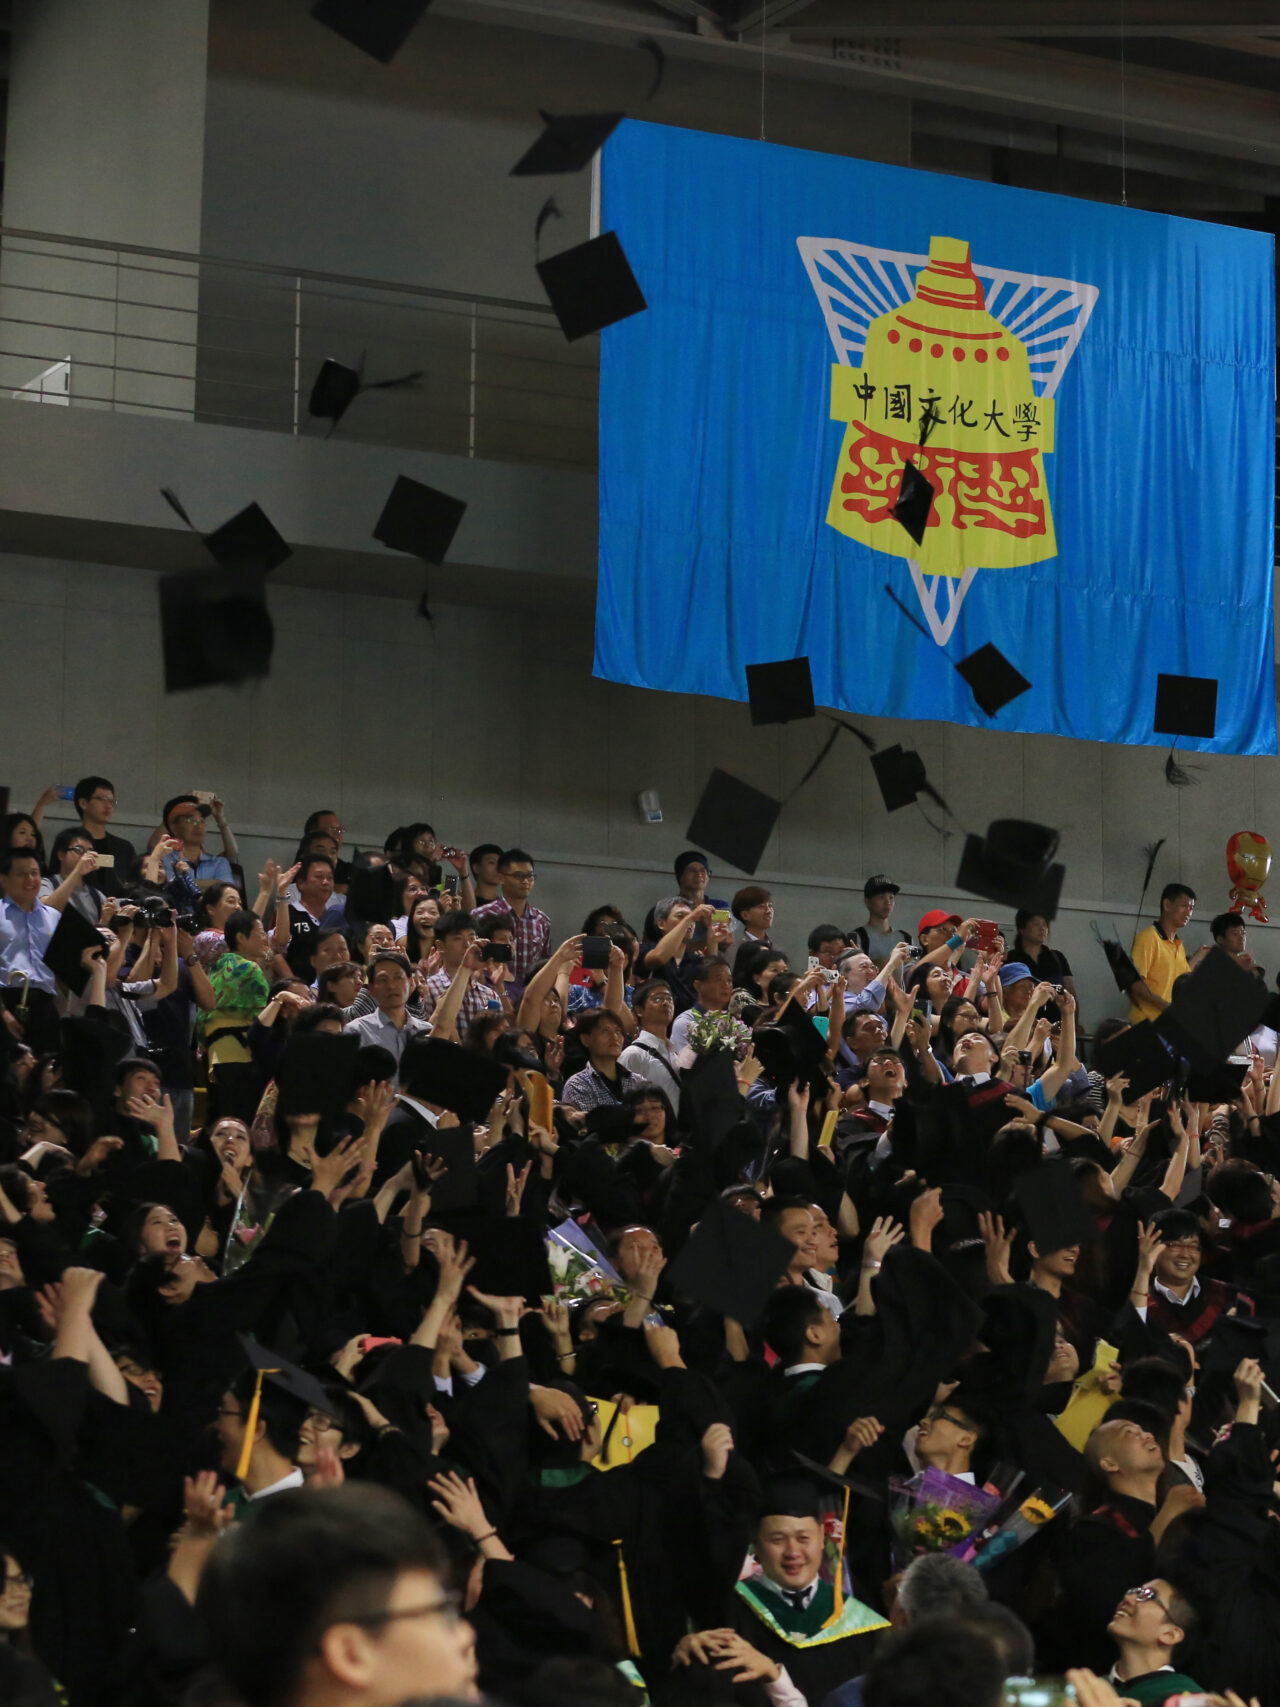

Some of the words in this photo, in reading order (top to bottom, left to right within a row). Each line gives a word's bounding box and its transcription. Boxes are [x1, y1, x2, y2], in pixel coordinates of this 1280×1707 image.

[853, 372, 1041, 442] 中國文化大學
[294, 922, 310, 934] 73
